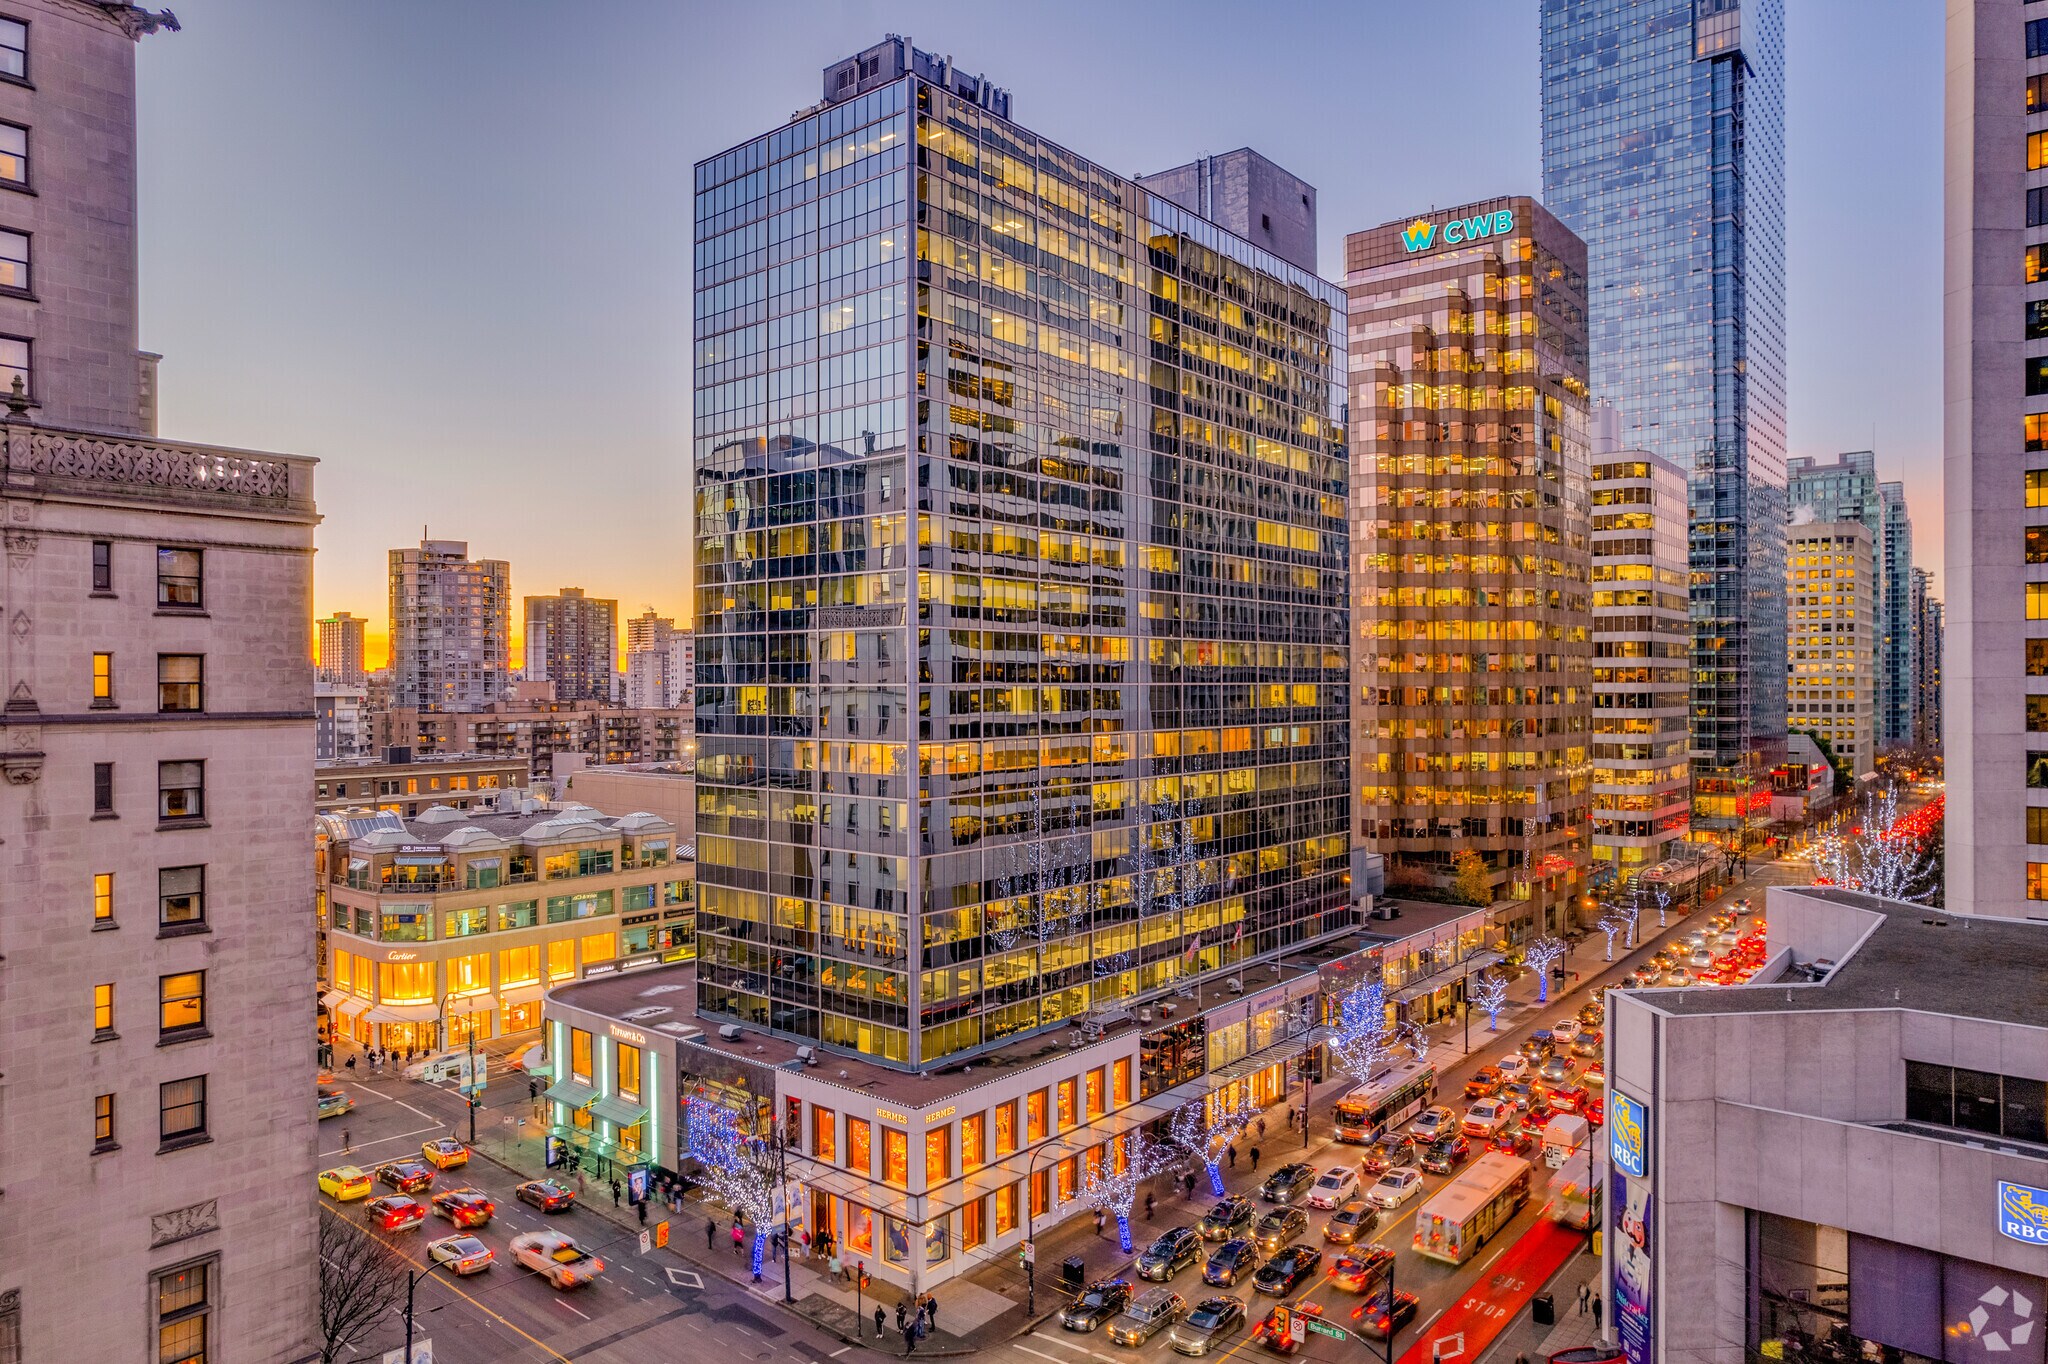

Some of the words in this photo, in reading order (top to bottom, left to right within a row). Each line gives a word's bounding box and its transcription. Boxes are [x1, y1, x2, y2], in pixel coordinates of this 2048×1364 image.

[1444, 209, 1514, 244] CWB
[388, 950, 417, 960] Cartier
[1614, 1142, 1640, 1173] RBC
[2006, 1221, 2048, 1242] RBC
[1493, 1274, 1525, 1291] BUS
[1463, 1298, 1506, 1319] STOP
[1310, 1323, 1334, 1336] Burrard
[1335, 1330, 1343, 1339] St
